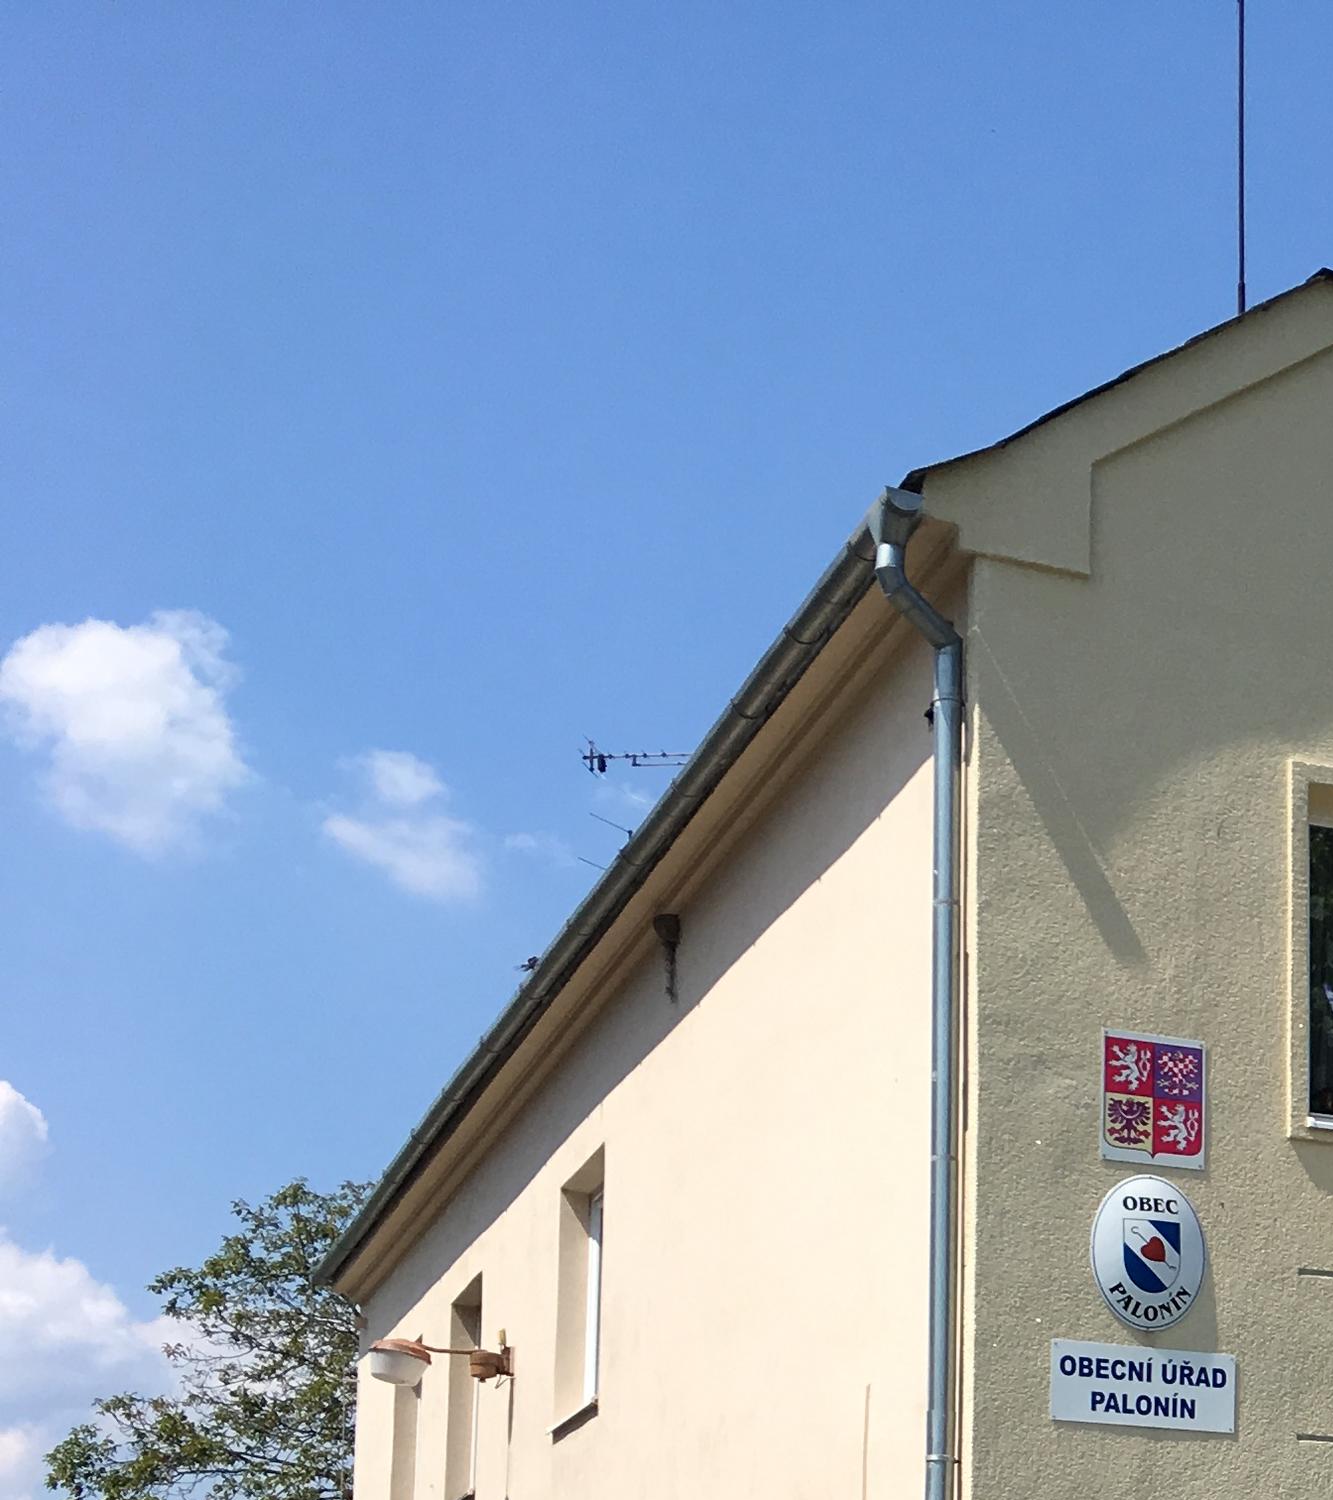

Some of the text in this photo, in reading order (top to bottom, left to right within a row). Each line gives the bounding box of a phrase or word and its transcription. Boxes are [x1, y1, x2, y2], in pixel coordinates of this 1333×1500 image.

[1122, 1196, 1179, 1214] OBEC
[1109, 1282, 1191, 1321] PALONÍN
[1059, 1355, 1227, 1388] OBECNÍ ÚŘAD
[1091, 1391, 1195, 1419] PALONÍN
